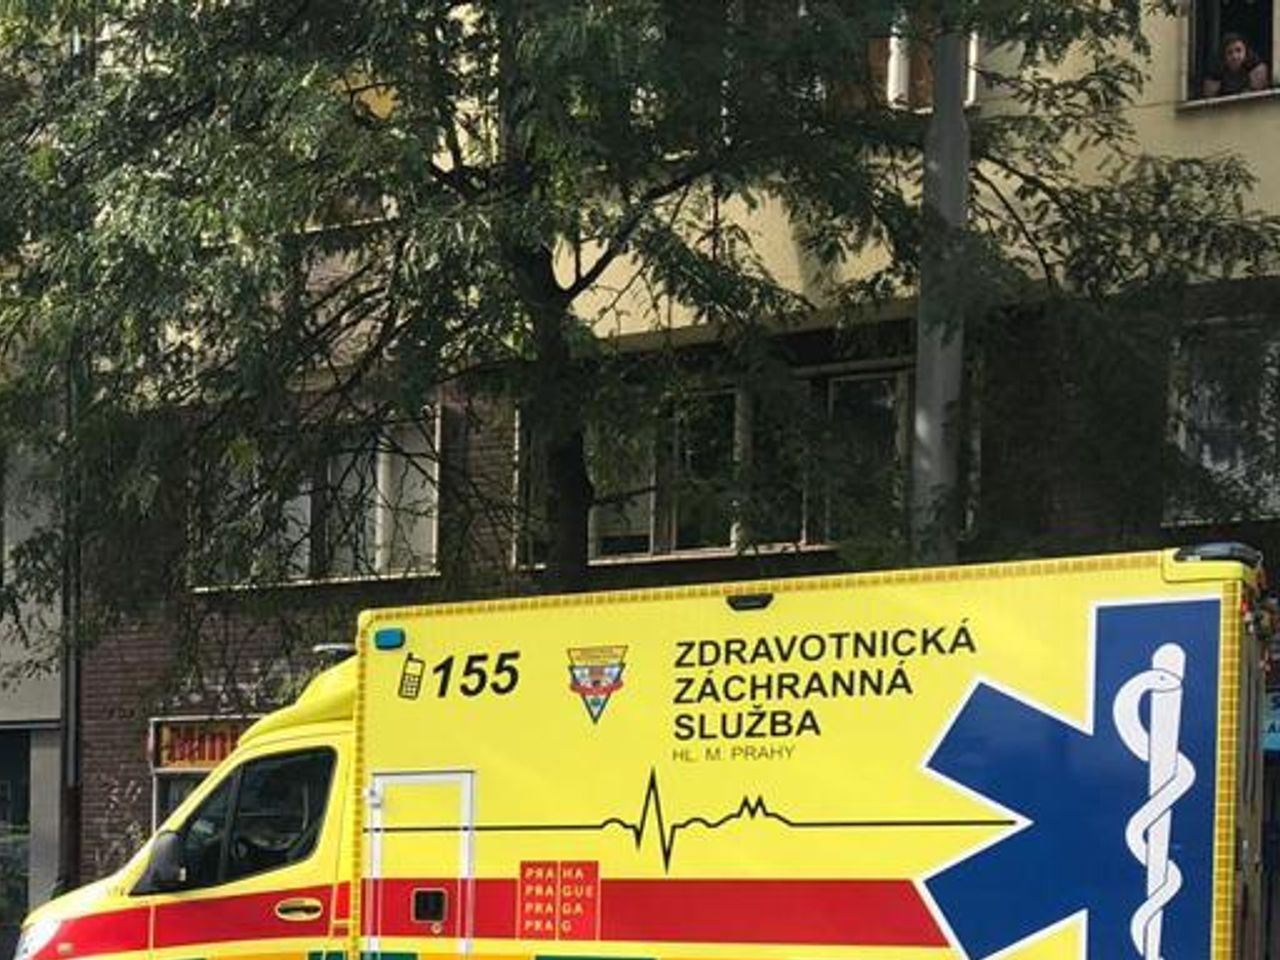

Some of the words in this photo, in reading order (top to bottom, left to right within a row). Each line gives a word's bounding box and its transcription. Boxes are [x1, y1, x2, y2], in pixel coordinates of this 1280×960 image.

[673, 617, 978, 669] ZDRAVOTNICKÁ
[432, 650, 521, 698] 155
[673, 660, 914, 704] ZÁCHRANNÁ
[673, 703, 822, 742] SLUŽBA
[672, 748, 696, 762] HL.
[731, 745, 796, 761] PRAHY
